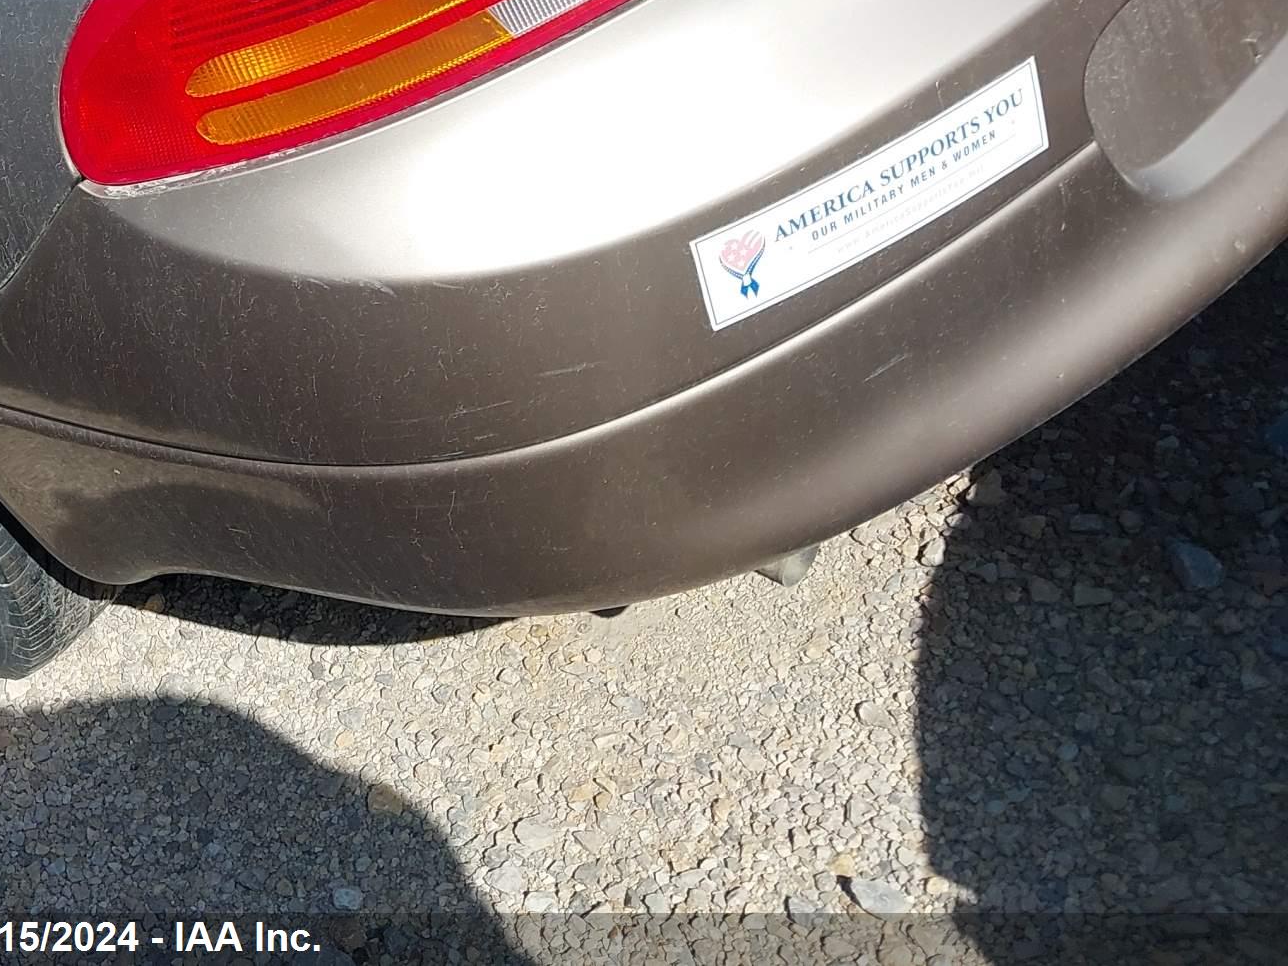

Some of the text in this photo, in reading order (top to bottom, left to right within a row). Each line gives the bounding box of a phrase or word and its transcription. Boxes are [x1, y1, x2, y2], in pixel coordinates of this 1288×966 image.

[774, 88, 1025, 243] AMERICA SUPPORTS YOU
[811, 129, 998, 242] OUR MILITARY MEN & WOMEN
